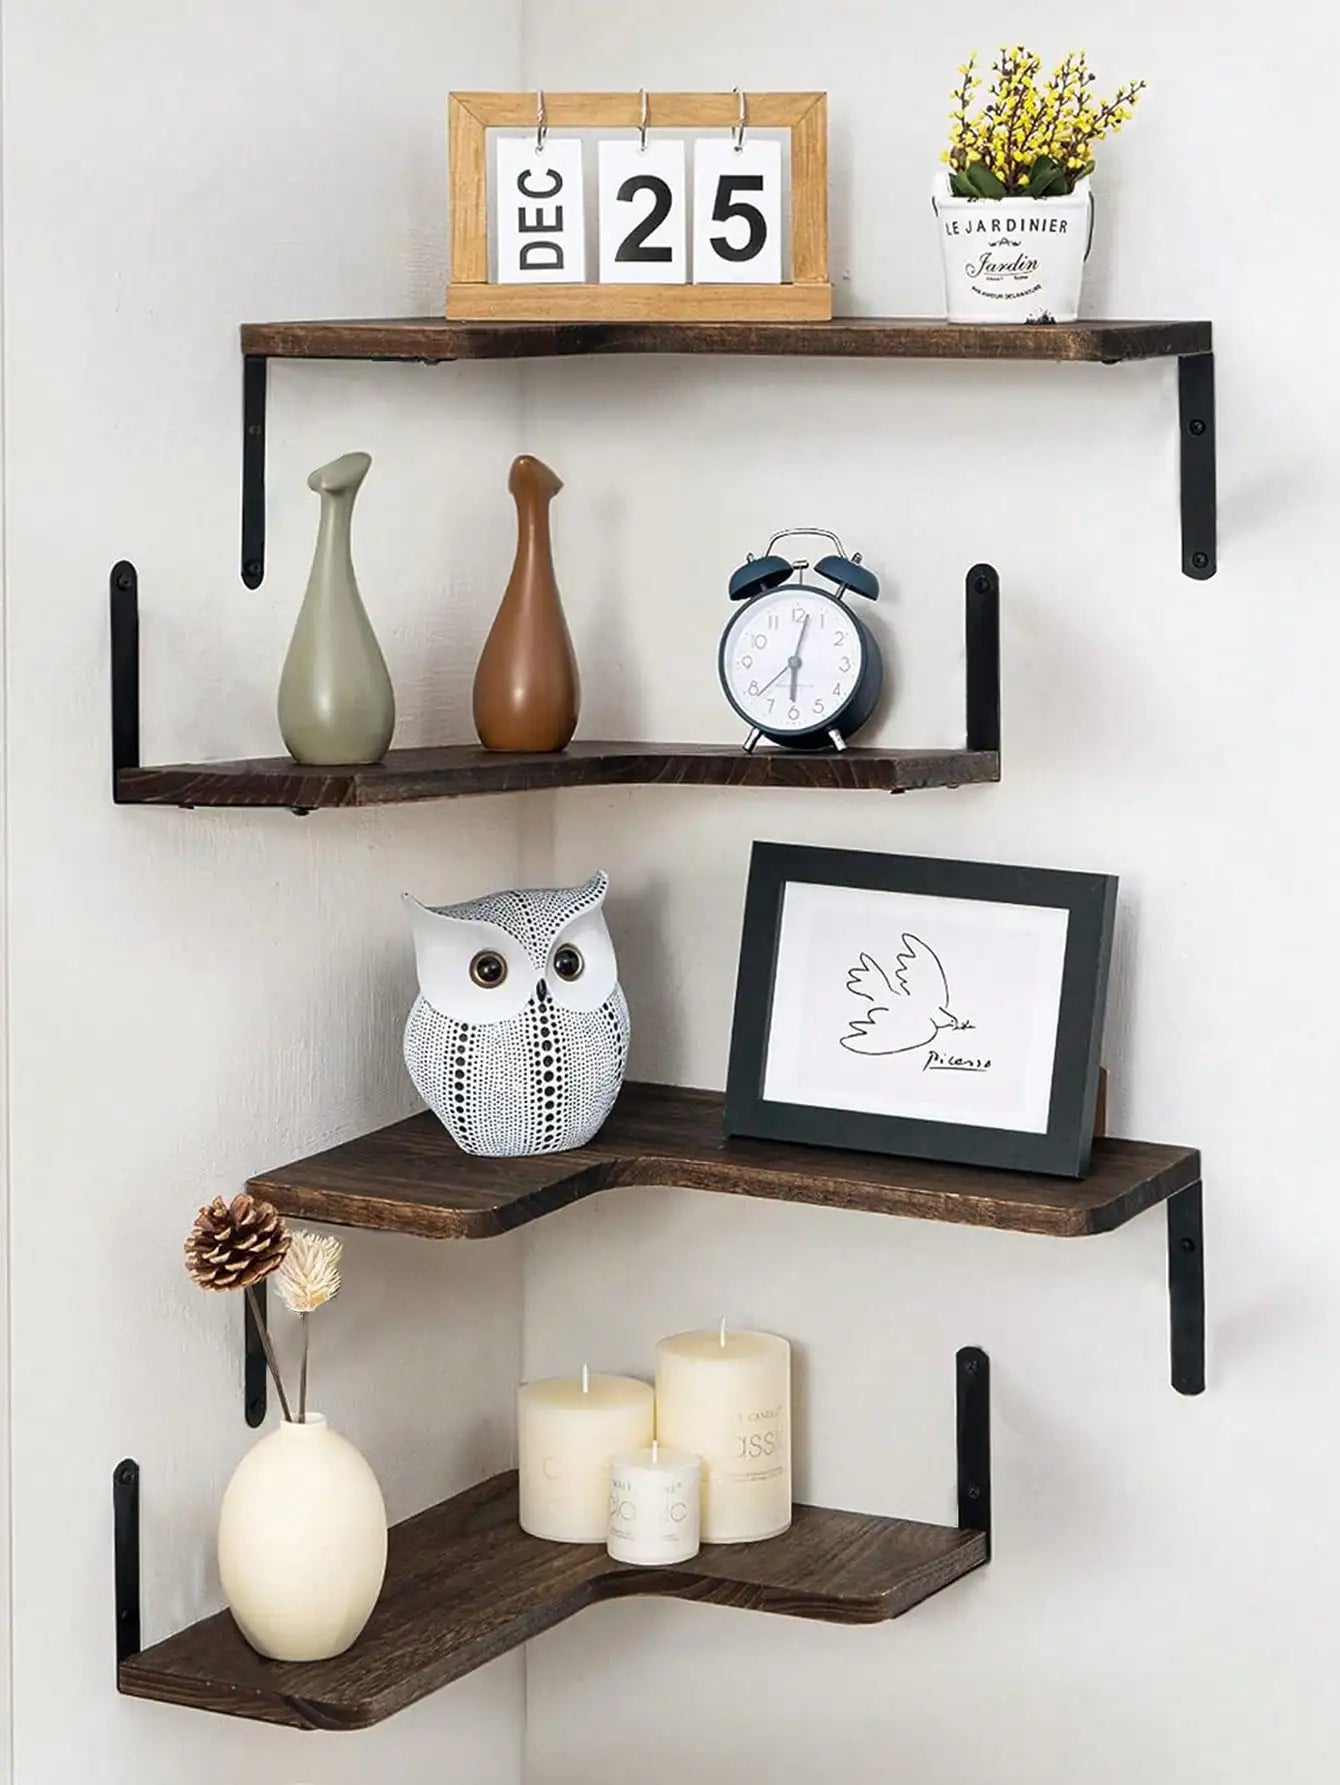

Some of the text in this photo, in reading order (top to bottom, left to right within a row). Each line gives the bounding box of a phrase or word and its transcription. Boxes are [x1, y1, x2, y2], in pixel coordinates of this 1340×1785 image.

[517, 168, 767, 270] DEC 2 5
[945, 218, 1068, 236] LE JARDINIER
[965, 252, 1040, 278] Jardin
[792, 608, 807, 623] 12
[820, 613, 825, 629] 1
[833, 631, 845, 646] 2
[838, 656, 851, 673] 3
[748, 680, 759, 696] 8
[832, 683, 841, 696] 4
[766, 699, 775, 713] 7
[788, 705, 800, 720] 6
[812, 699, 825, 714] 5
[922, 1050, 991, 1072] Picasso
